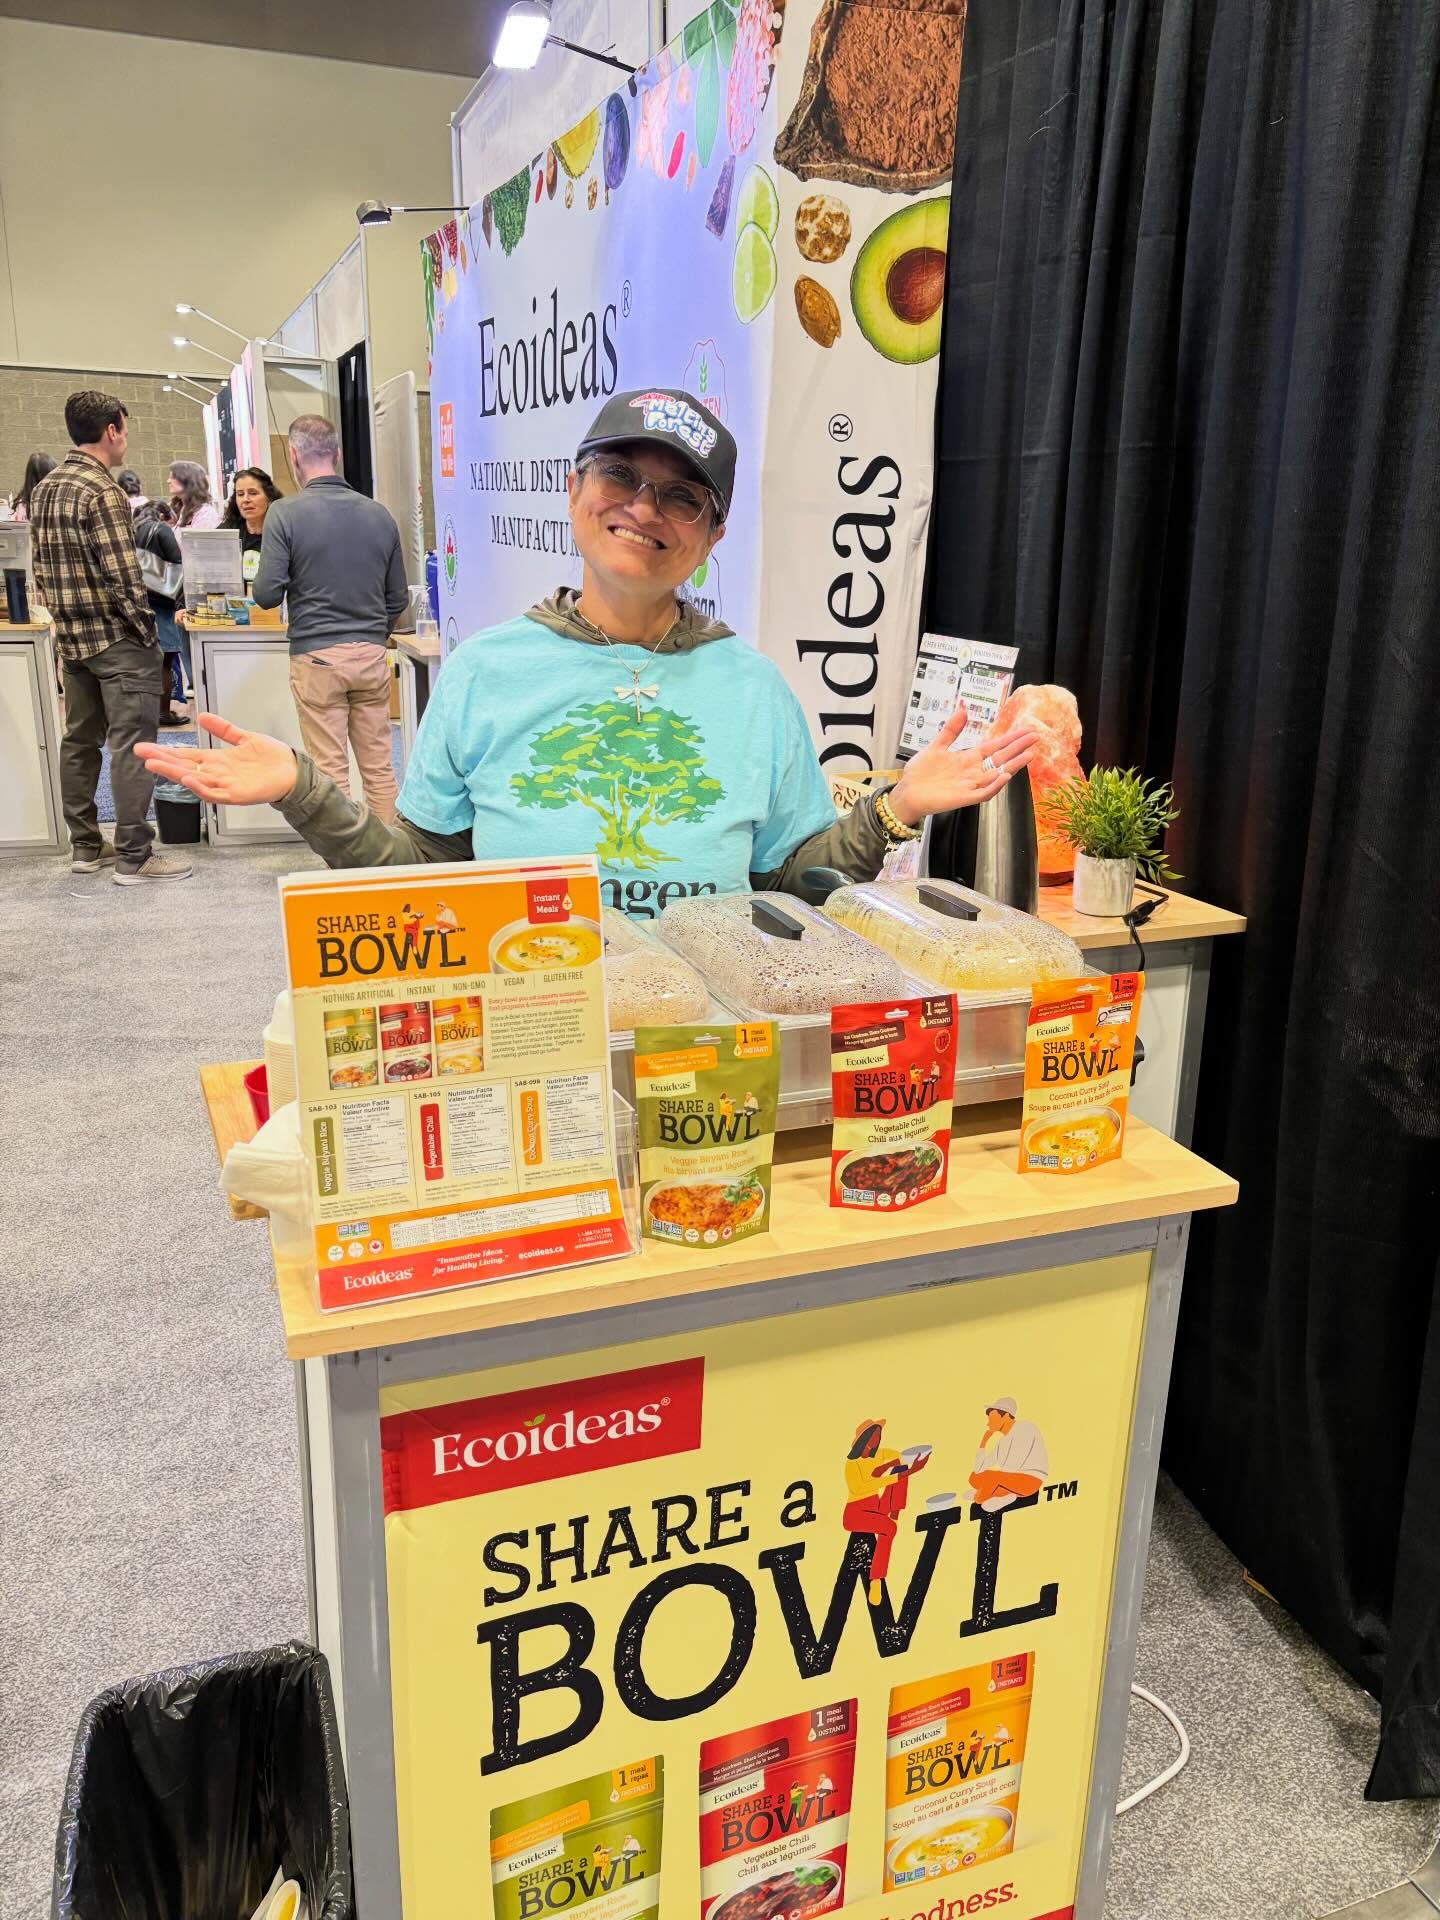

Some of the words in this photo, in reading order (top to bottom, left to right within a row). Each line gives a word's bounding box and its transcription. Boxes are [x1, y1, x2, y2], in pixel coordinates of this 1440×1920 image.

[470, 461, 527, 492] NATIONAL
[533, 893, 561, 904] Instant
[536, 904, 559, 914] Meals
[316, 914, 380, 934] SHARE
[387, 915, 397, 928] a
[503, 976, 525, 987] VEGAN
[543, 972, 567, 983] GLUTEN
[568, 971, 584, 980] FREE
[406, 985, 436, 996] INSTANT
[452, 980, 486, 992] NON-GMO
[322, 991, 355, 1003] NOTHING
[357, 988, 394, 1000] ARTIFICIAL
[925, 1002, 932, 1016] 1
[741, 1029, 748, 1044] 1
[1043, 1040, 1078, 1055] SHARE
[1041, 1047, 1119, 1082] BOWL
[854, 1071, 897, 1086] SHARE
[899, 1073, 906, 1083] a
[853, 1080, 940, 1115] BOWL
[308, 1104, 337, 1112] SAB-103
[659, 1099, 703, 1113] SHARE
[706, 1101, 714, 1112] a
[1028, 1103, 1051, 1112] Soupe
[659, 1110, 760, 1145] BOWL
[873, 1121, 909, 1134] Vegetable
[911, 1116, 926, 1127] Chili
[482, 1248, 503, 1257] Ideas
[518, 1245, 564, 1260] ecoideas.ca
[432, 1266, 445, 1276] for
[447, 1259, 478, 1272] Healthy
[482, 1478, 753, 1608] SHARE
[779, 1479, 817, 1528] a
[816, 1711, 824, 1727] 1
[826, 1708, 842, 1717] meal
[826, 1715, 844, 1724] repas
[907, 1741, 953, 1767] SHARE
[957, 1741, 965, 1751] a
[618, 1770, 628, 1787] 1
[630, 1764, 647, 1776] meal
[630, 1772, 649, 1783] repas
[912, 1796, 948, 1813] Coconut
[949, 1786, 974, 1801] Curry
[975, 1778, 996, 1790] Soup
[722, 1795, 773, 1822] SHARE
[777, 1793, 785, 1804] a
[892, 1818, 916, 1832] Soupe
[917, 1814, 927, 1822] au
[928, 1808, 944, 1818] cari
[945, 1804, 953, 1812] et
[961, 1798, 969, 1806] la
[970, 1791, 988, 1802] noix
[989, 1787, 998, 1795] de
[999, 1778, 1016, 1791] coco
[743, 1843, 787, 1865] Vegetable
[788, 1834, 810, 1848] Chili
[737, 1864, 759, 1878] Chili
[760, 1859, 778, 1870] aux
[780, 1842, 817, 1863] légumes
[518, 1859, 574, 1890] SHARE
[578, 1857, 589, 1869] a
[879, 1881, 1018, 1920] dness.
